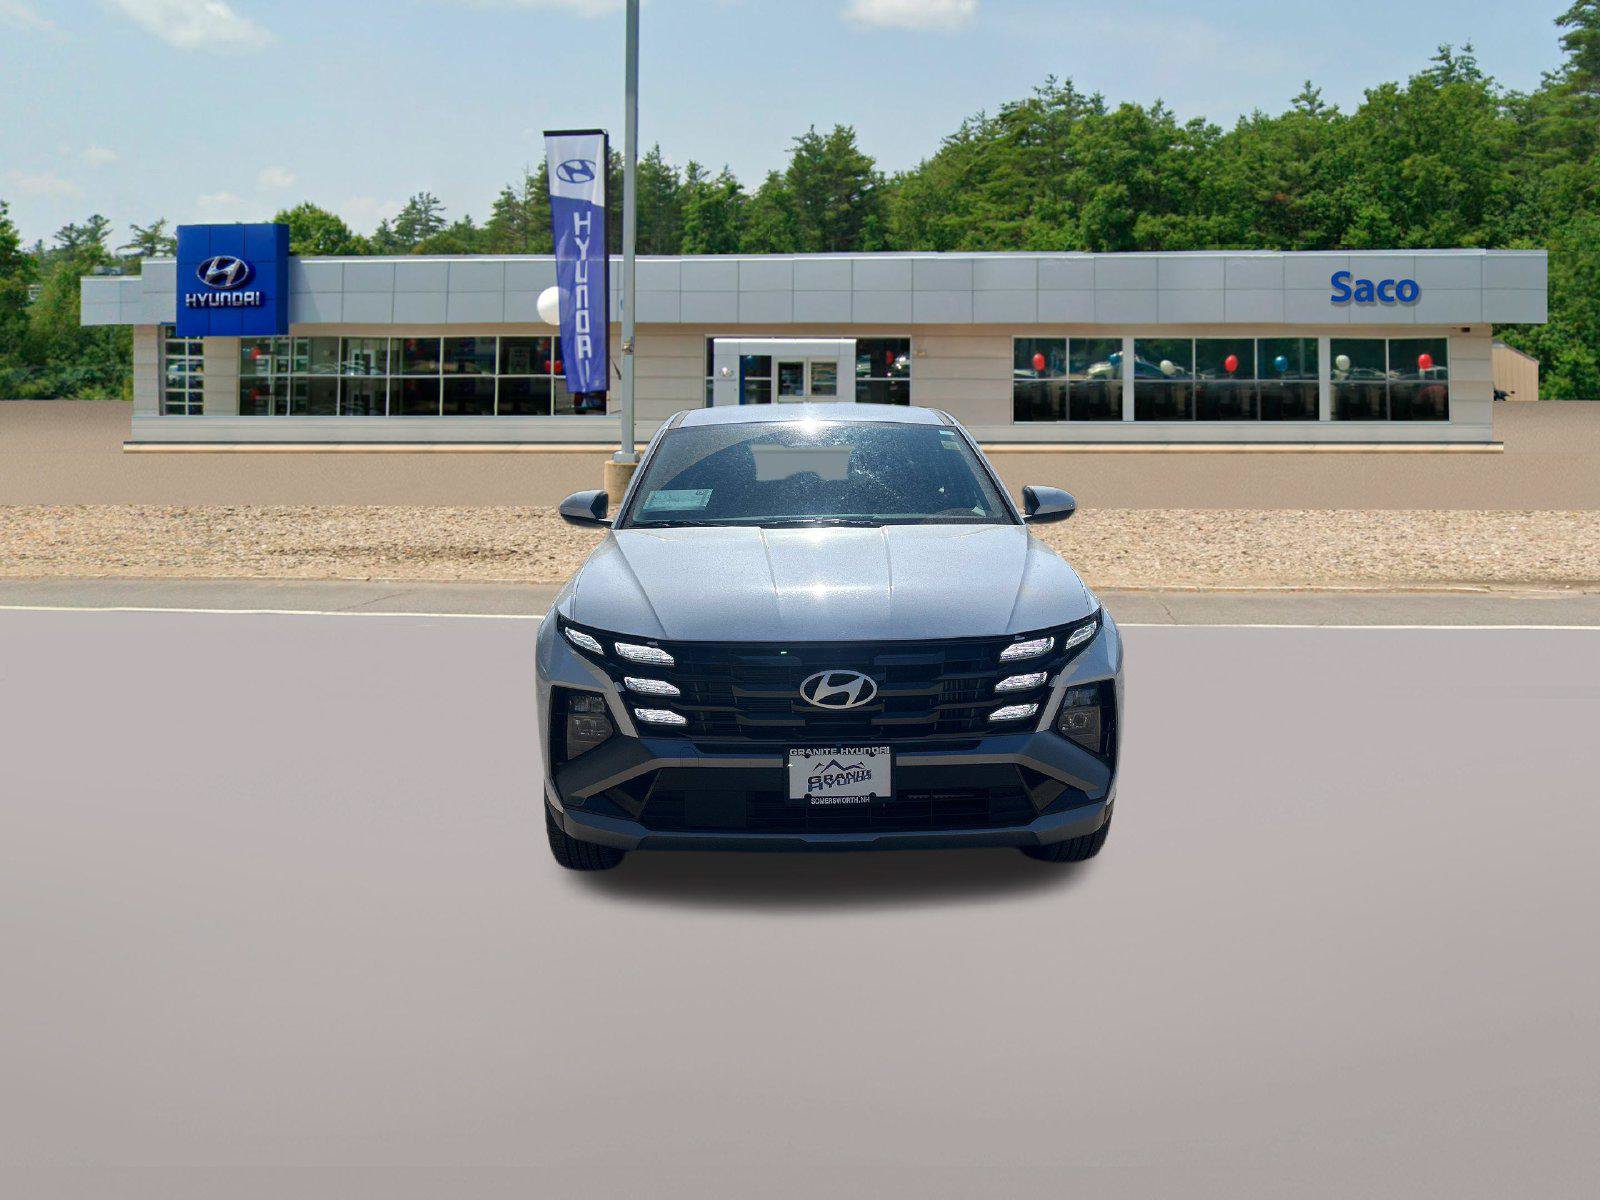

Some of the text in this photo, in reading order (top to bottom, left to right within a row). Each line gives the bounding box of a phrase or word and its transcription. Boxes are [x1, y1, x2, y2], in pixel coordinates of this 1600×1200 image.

[573, 211, 592, 384] HYUNDAI
[1330, 270, 1420, 303] Saco
[185, 291, 260, 307] HYUNDAI
[789, 746, 890, 756] GRANITE HYUNDAI
